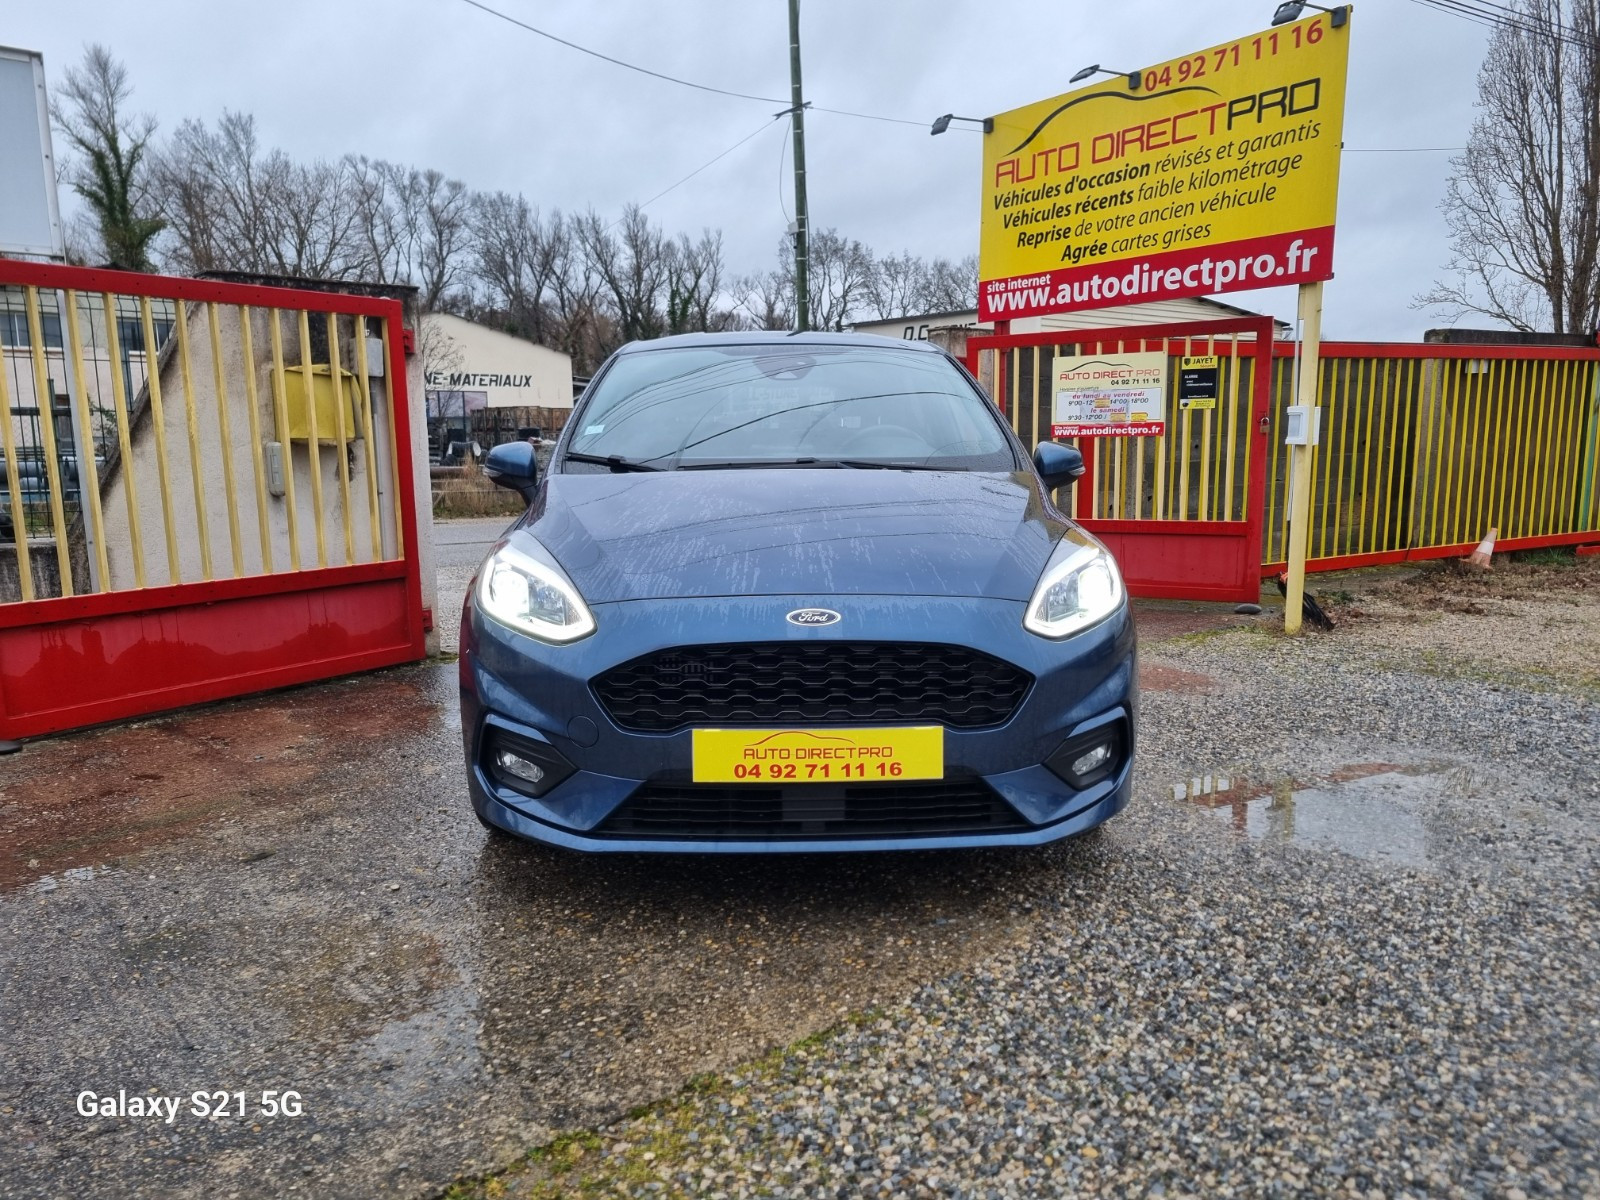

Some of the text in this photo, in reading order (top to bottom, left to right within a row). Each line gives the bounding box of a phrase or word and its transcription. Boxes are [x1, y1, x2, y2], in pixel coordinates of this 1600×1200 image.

[1145, 19, 1324, 92] 04 92 71 11 16
[994, 119, 1321, 210] Véhicules d'occasion révisés et garantis
[996, 142, 1080, 188] AUTO
[1003, 154, 1303, 229] Véhicules récents faible kilométrage
[1017, 182, 1277, 249] Reprise de votre ancien véhicule
[1061, 223, 1212, 264] Agrée cartes grises
[987, 239, 1319, 313] www.autodirectpro.fr
[987, 273, 1051, 293] site internet
[1060, 368, 1161, 381] AUTO DIRECT PRO
[1113, 390, 1145, 398] vendredi
[1054, 425, 1161, 437] www.autodirectpro.fr
[798, 611, 829, 623] Ford
[743, 748, 791, 760] AUTO
[734, 762, 903, 779] 04 92 71 11 16
